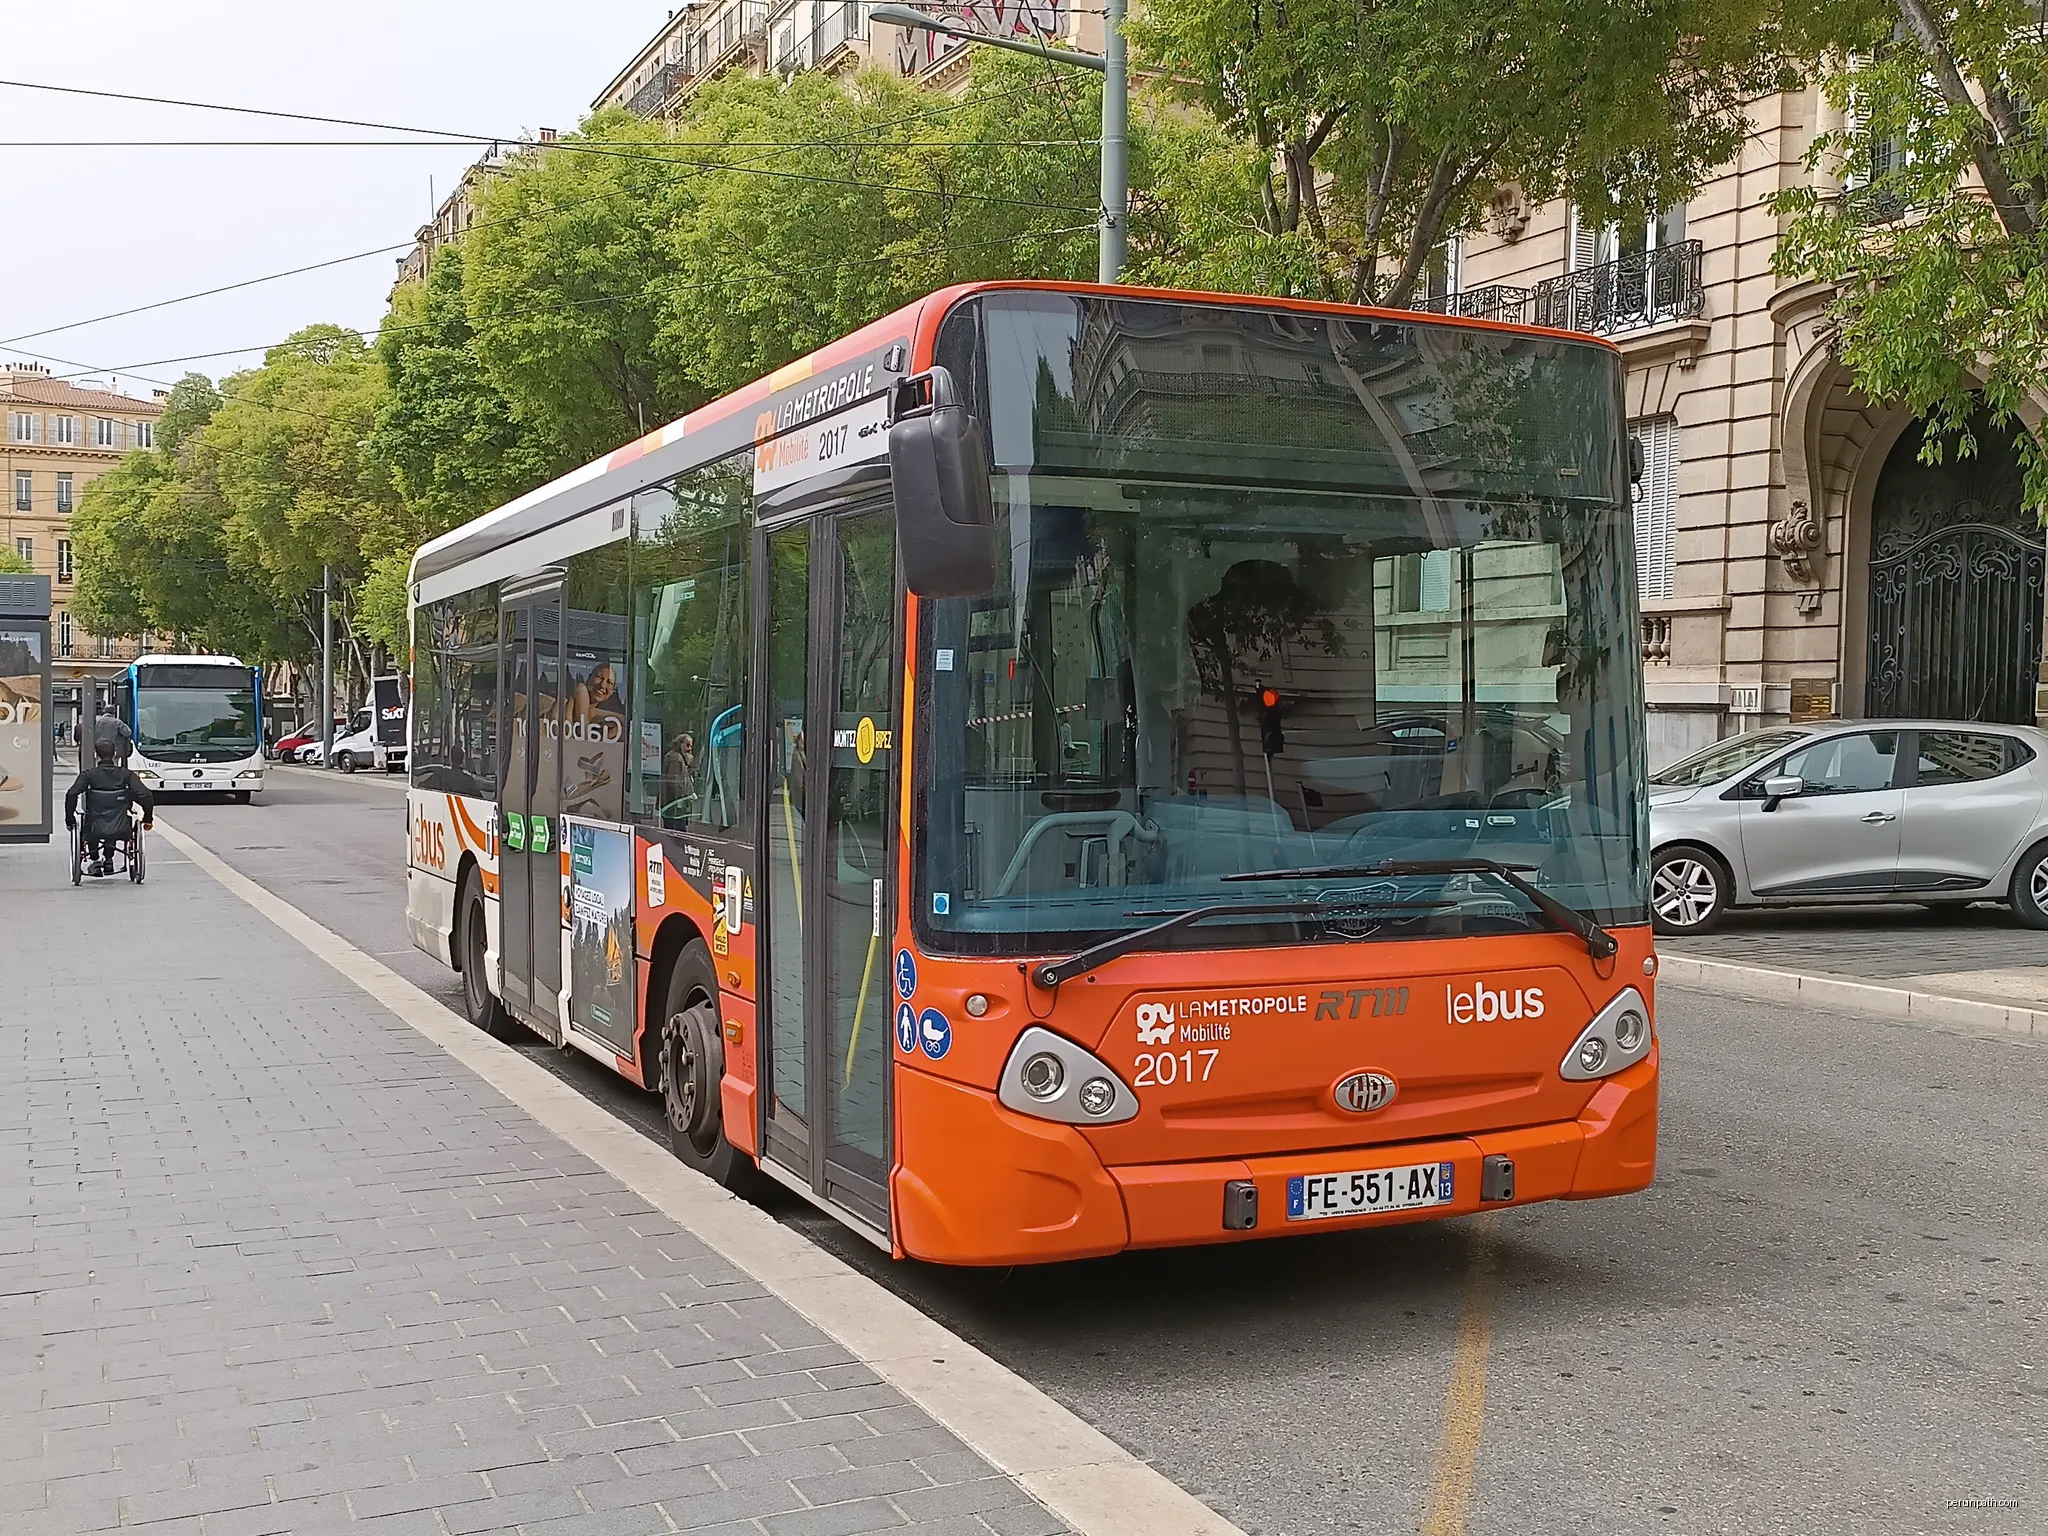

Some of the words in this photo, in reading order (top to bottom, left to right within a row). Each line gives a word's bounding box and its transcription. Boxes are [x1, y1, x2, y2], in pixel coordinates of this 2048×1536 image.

[819, 424, 848, 461] 2017
[1447, 981, 1545, 1024] lebus
[1180, 1022, 1231, 1043] Mobilité
[1133, 1049, 1220, 1087] 2017
[1293, 1199, 1299, 1209] F
[1307, 1167, 1436, 1210] FE-551-AX
[1440, 1182, 1452, 1197] 13
